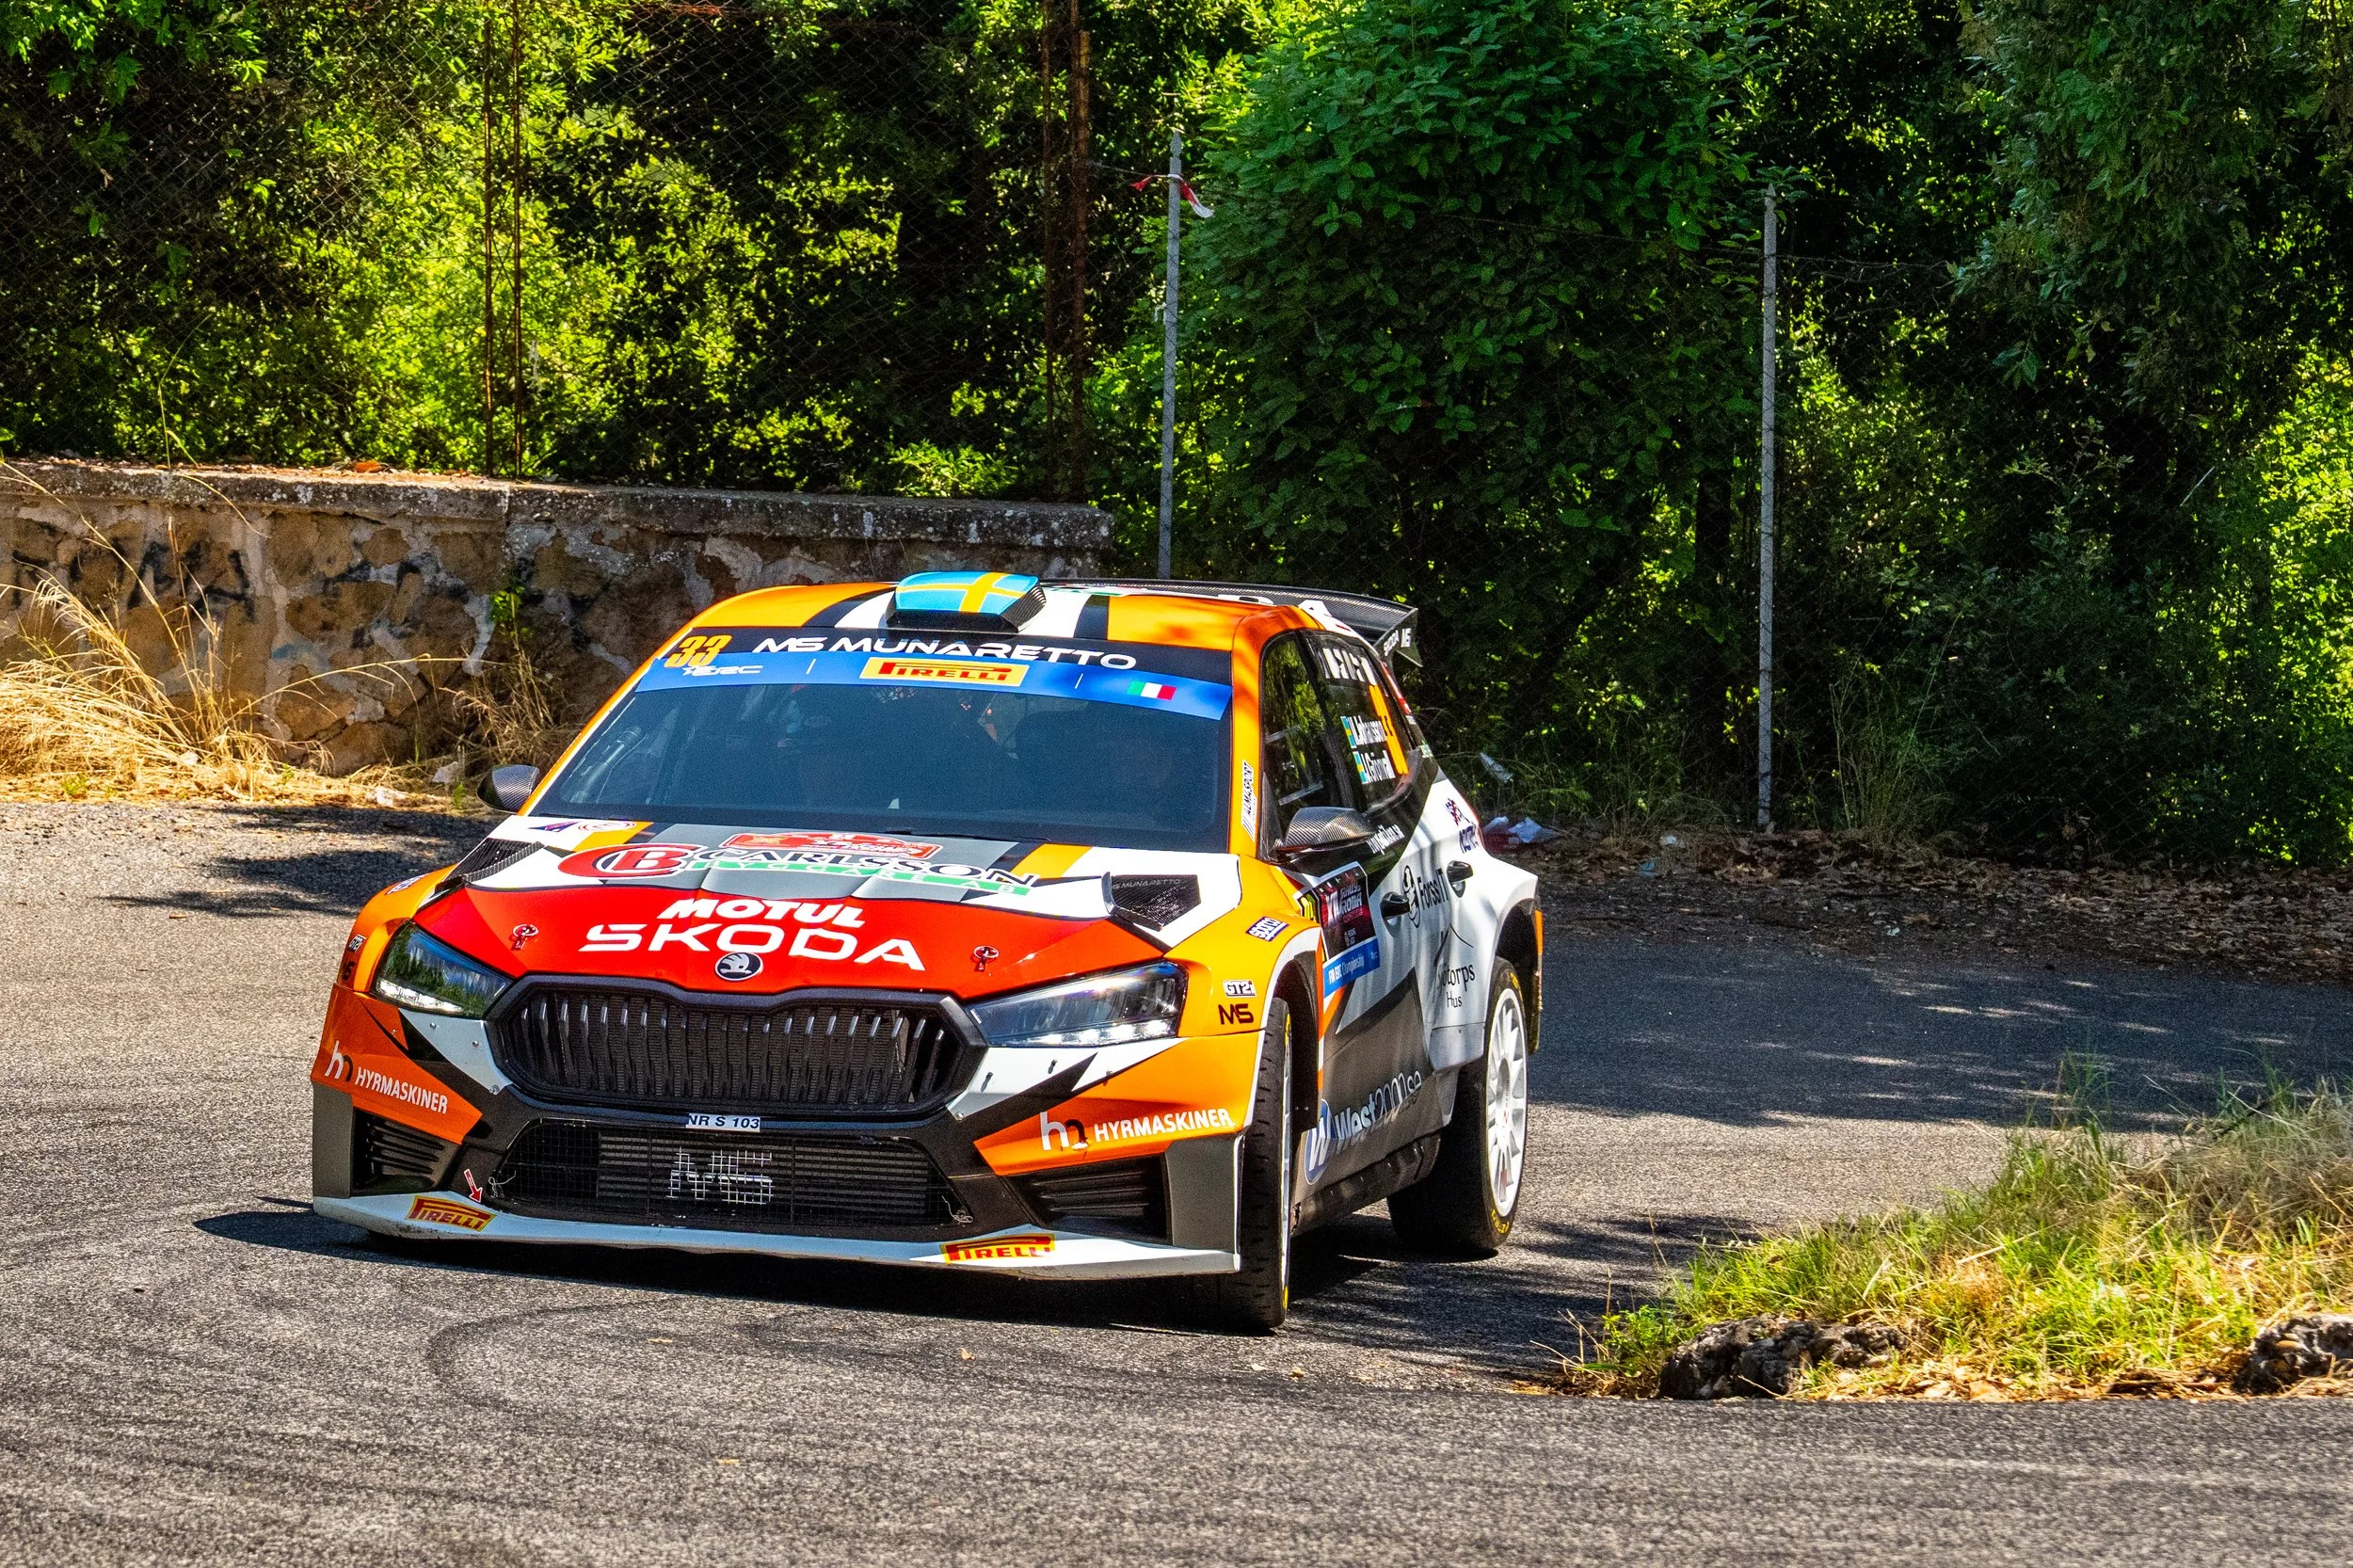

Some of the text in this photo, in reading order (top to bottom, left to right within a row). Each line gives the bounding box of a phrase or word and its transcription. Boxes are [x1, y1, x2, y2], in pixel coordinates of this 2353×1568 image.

[664, 635, 732, 668] 33
[751, 637, 1137, 670] MS MUNARETTO
[878, 662, 1011, 680] PIRELLI
[693, 847, 1041, 888] CARLSSON
[960, 878, 1017, 894] AB
[656, 898, 866, 928] MOTUL
[578, 923, 926, 971] SKODA
[1218, 1003, 1255, 1026] MS
[1446, 991, 1463, 1009] Hus
[354, 1066, 449, 1114] HYRMASKINER
[687, 1114, 760, 1129] NR S 103
[1094, 1108, 1232, 1143] HYRMASKINER
[408, 1198, 491, 1230] PIRELLI
